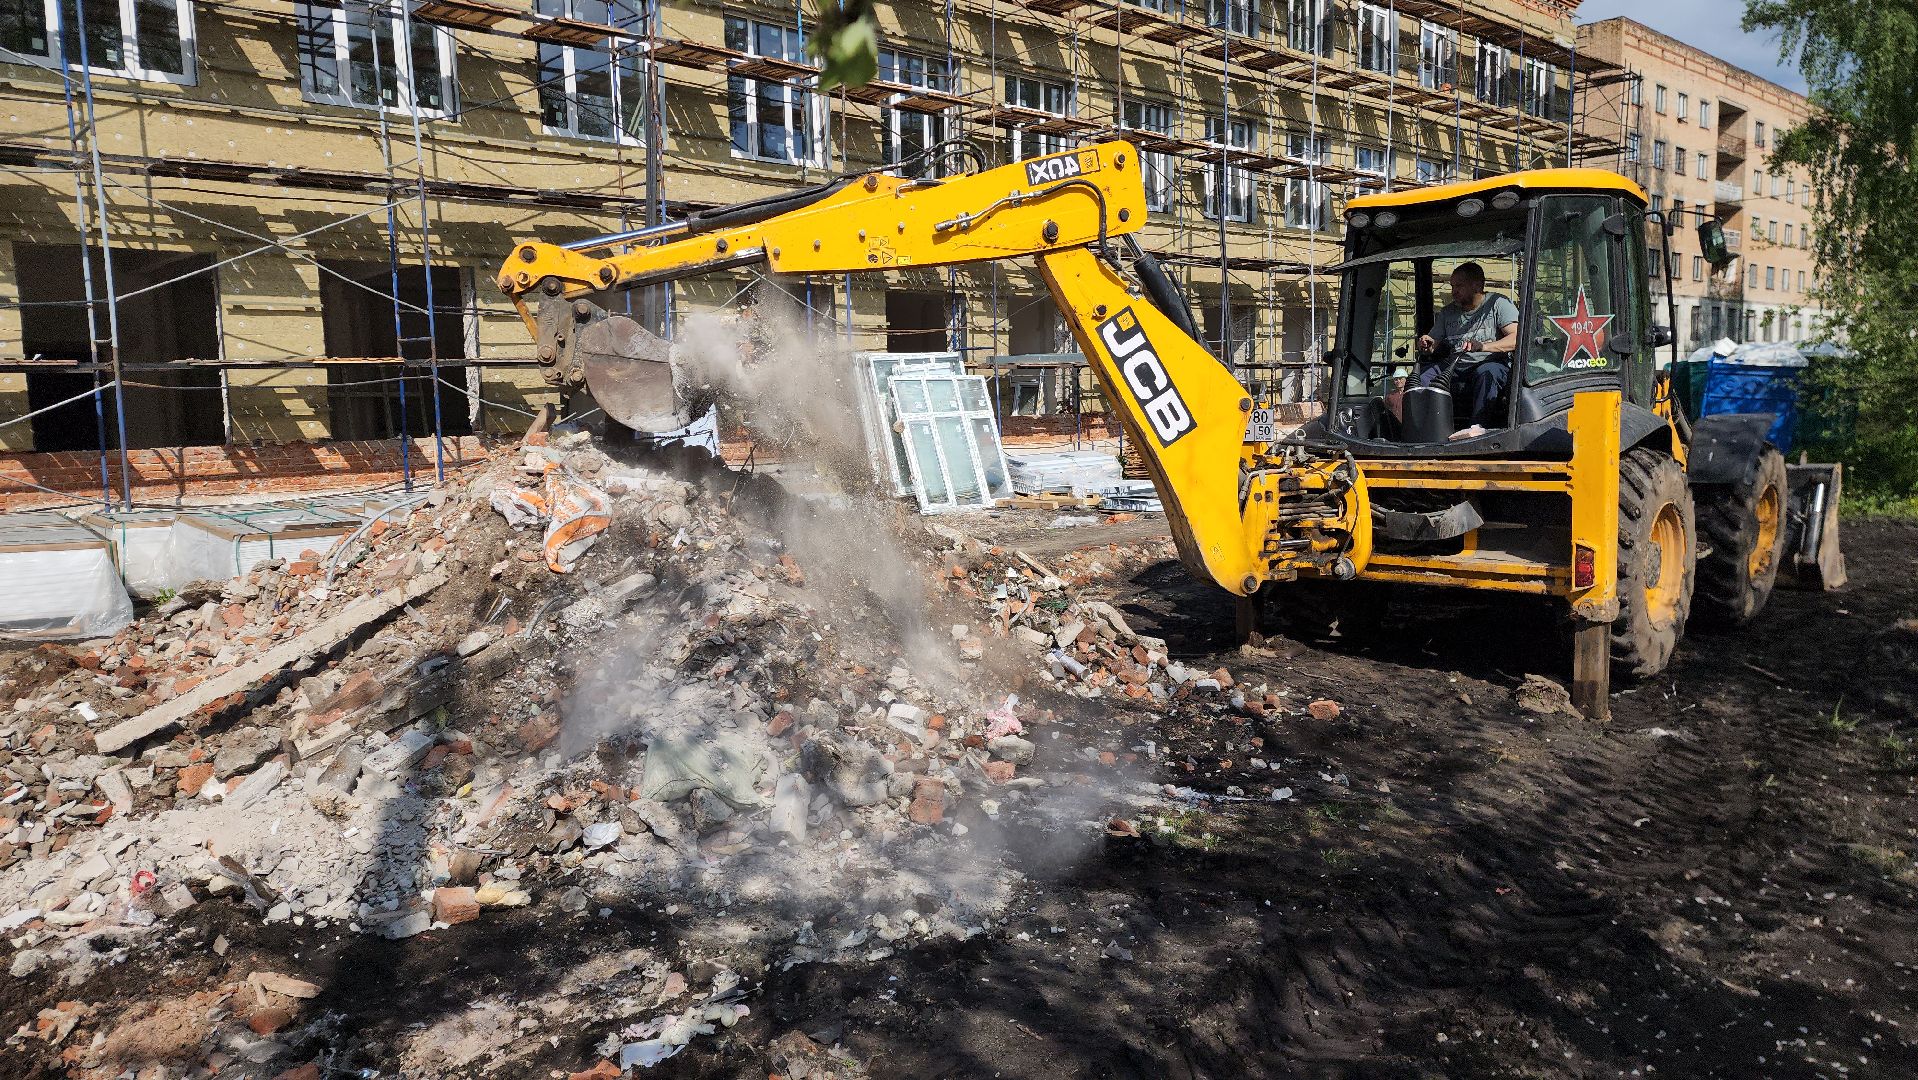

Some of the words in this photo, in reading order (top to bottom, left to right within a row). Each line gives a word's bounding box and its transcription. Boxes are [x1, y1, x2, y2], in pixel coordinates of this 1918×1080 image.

[1032, 157, 1080, 184] 4CX
[1572, 321, 1593, 335] 1942
[1102, 321, 1190, 442] JCB
[1258, 426, 1270, 436] 50
